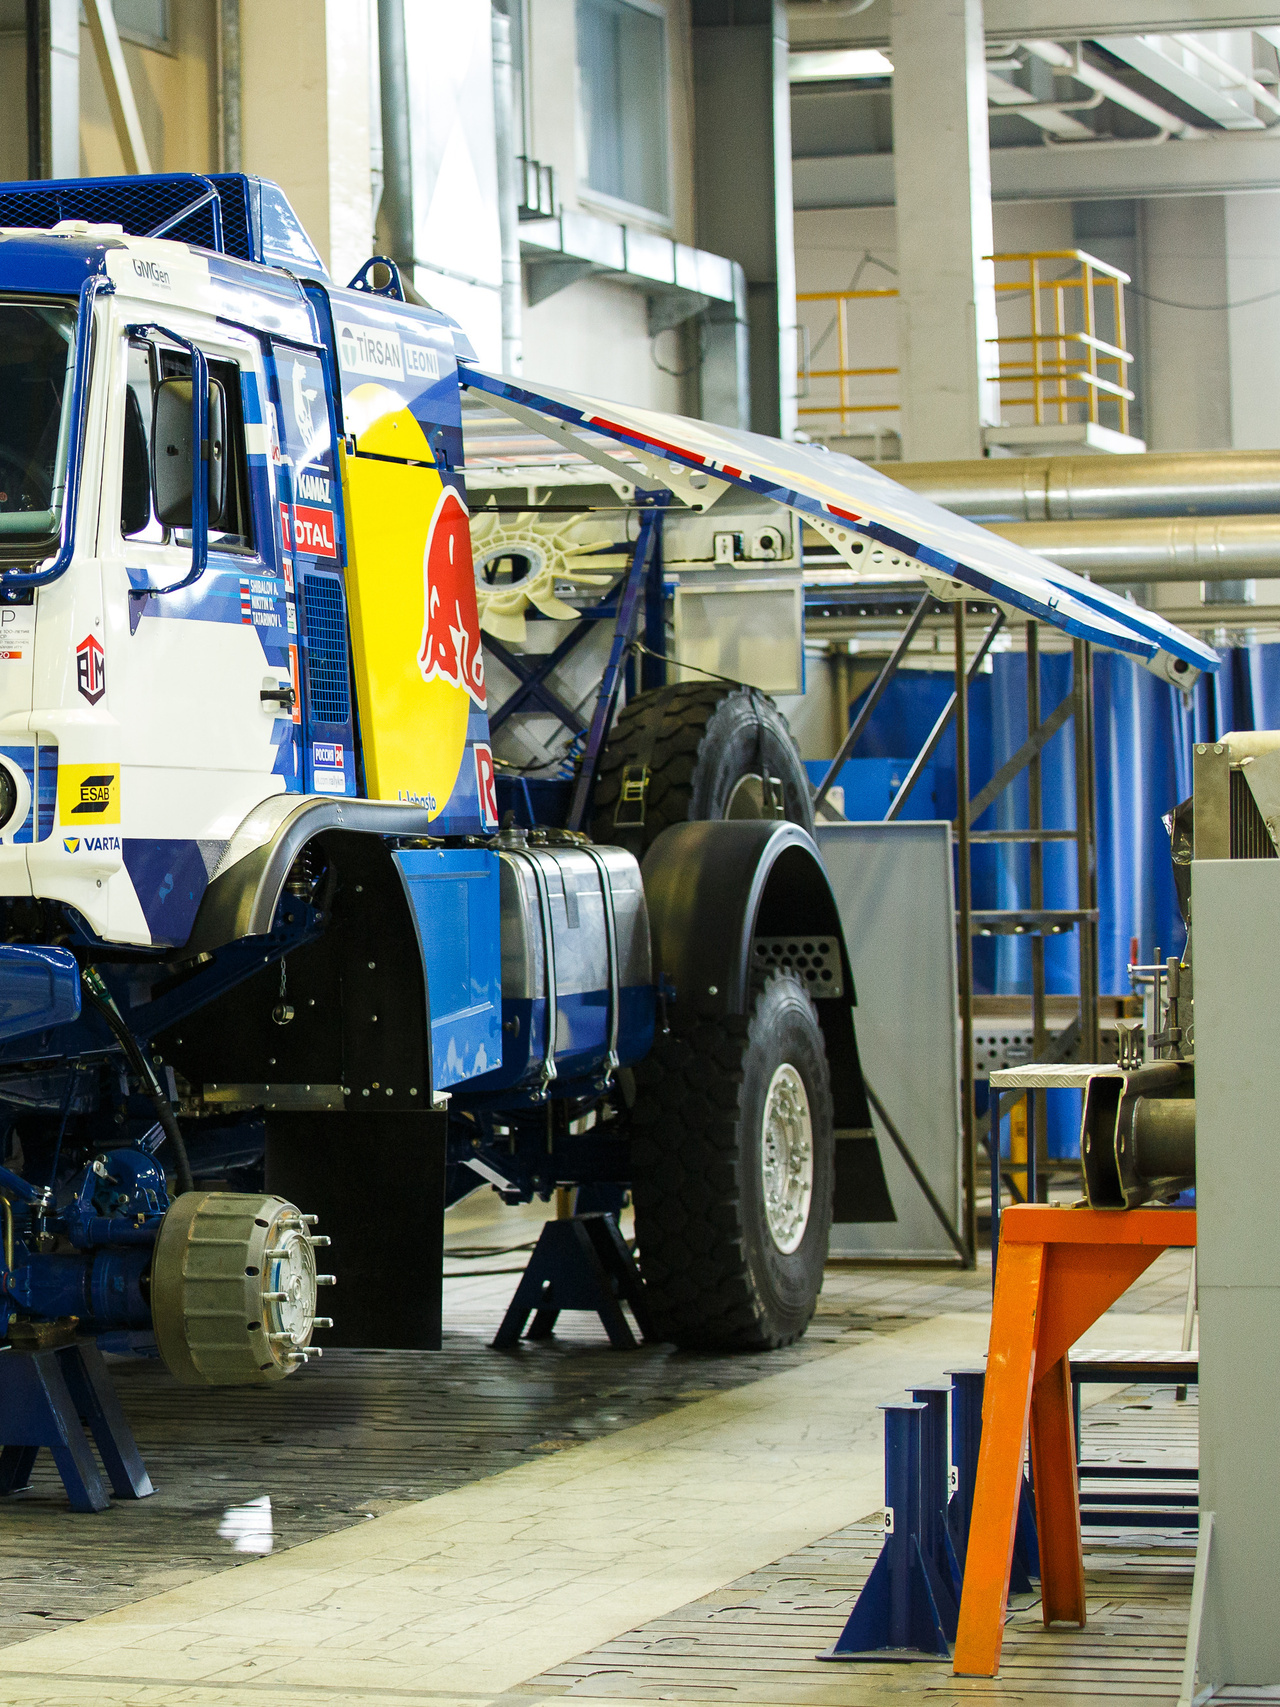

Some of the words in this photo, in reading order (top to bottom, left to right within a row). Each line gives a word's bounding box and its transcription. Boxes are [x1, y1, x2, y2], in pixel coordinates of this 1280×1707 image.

[132, 258, 170, 284] GMGen
[406, 349, 438, 374] LEONI
[298, 474, 332, 504] KAMAZ
[282, 511, 333, 549] TOTAL
[315, 748, 335, 761] РОССИЯ
[80, 787, 110, 801] ESAB
[83, 836, 120, 851] VARTA
[885, 1513, 891, 1527] 6
